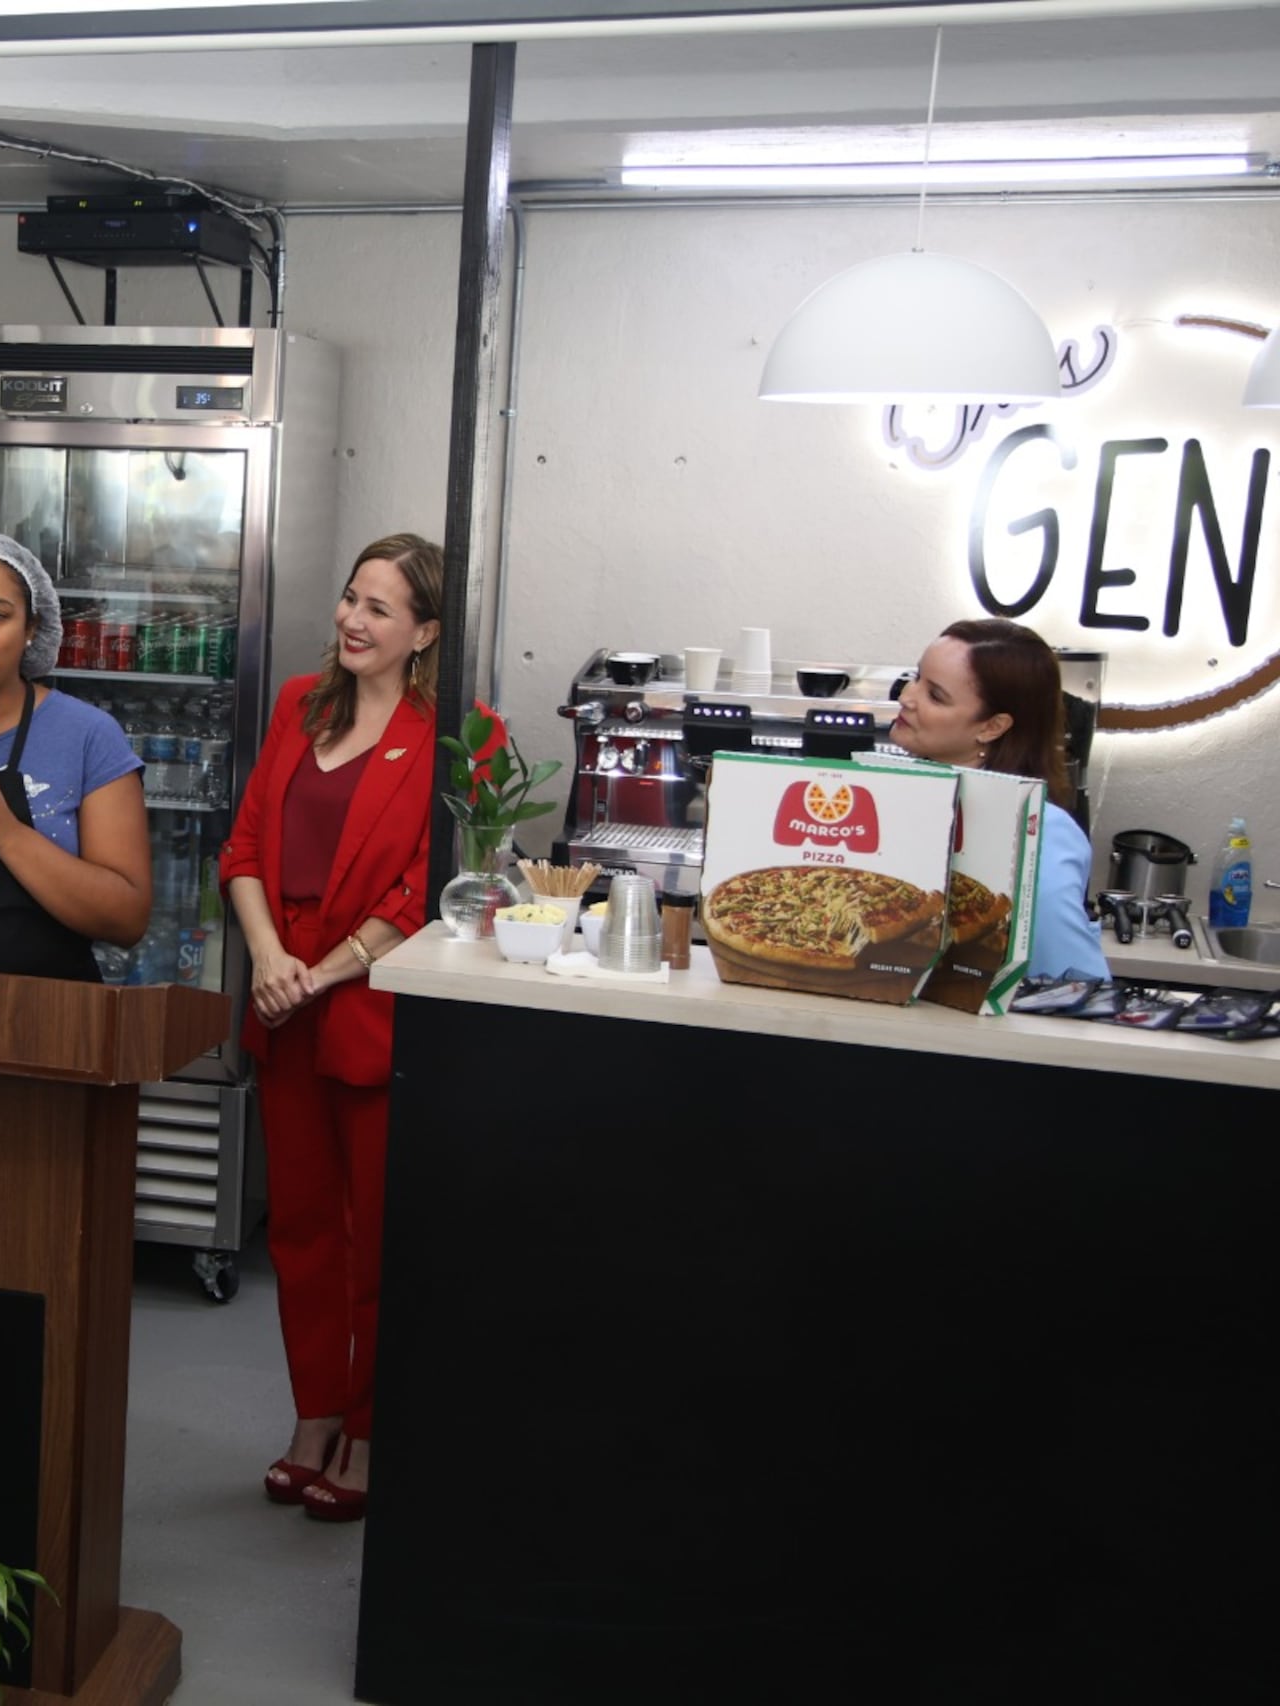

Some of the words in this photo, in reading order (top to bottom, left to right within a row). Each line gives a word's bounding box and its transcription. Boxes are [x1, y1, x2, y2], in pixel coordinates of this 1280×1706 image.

[968, 423, 1271, 648] GEN
[789, 819, 866, 837] MARCO'S
[802, 850, 846, 864] PIZZA
